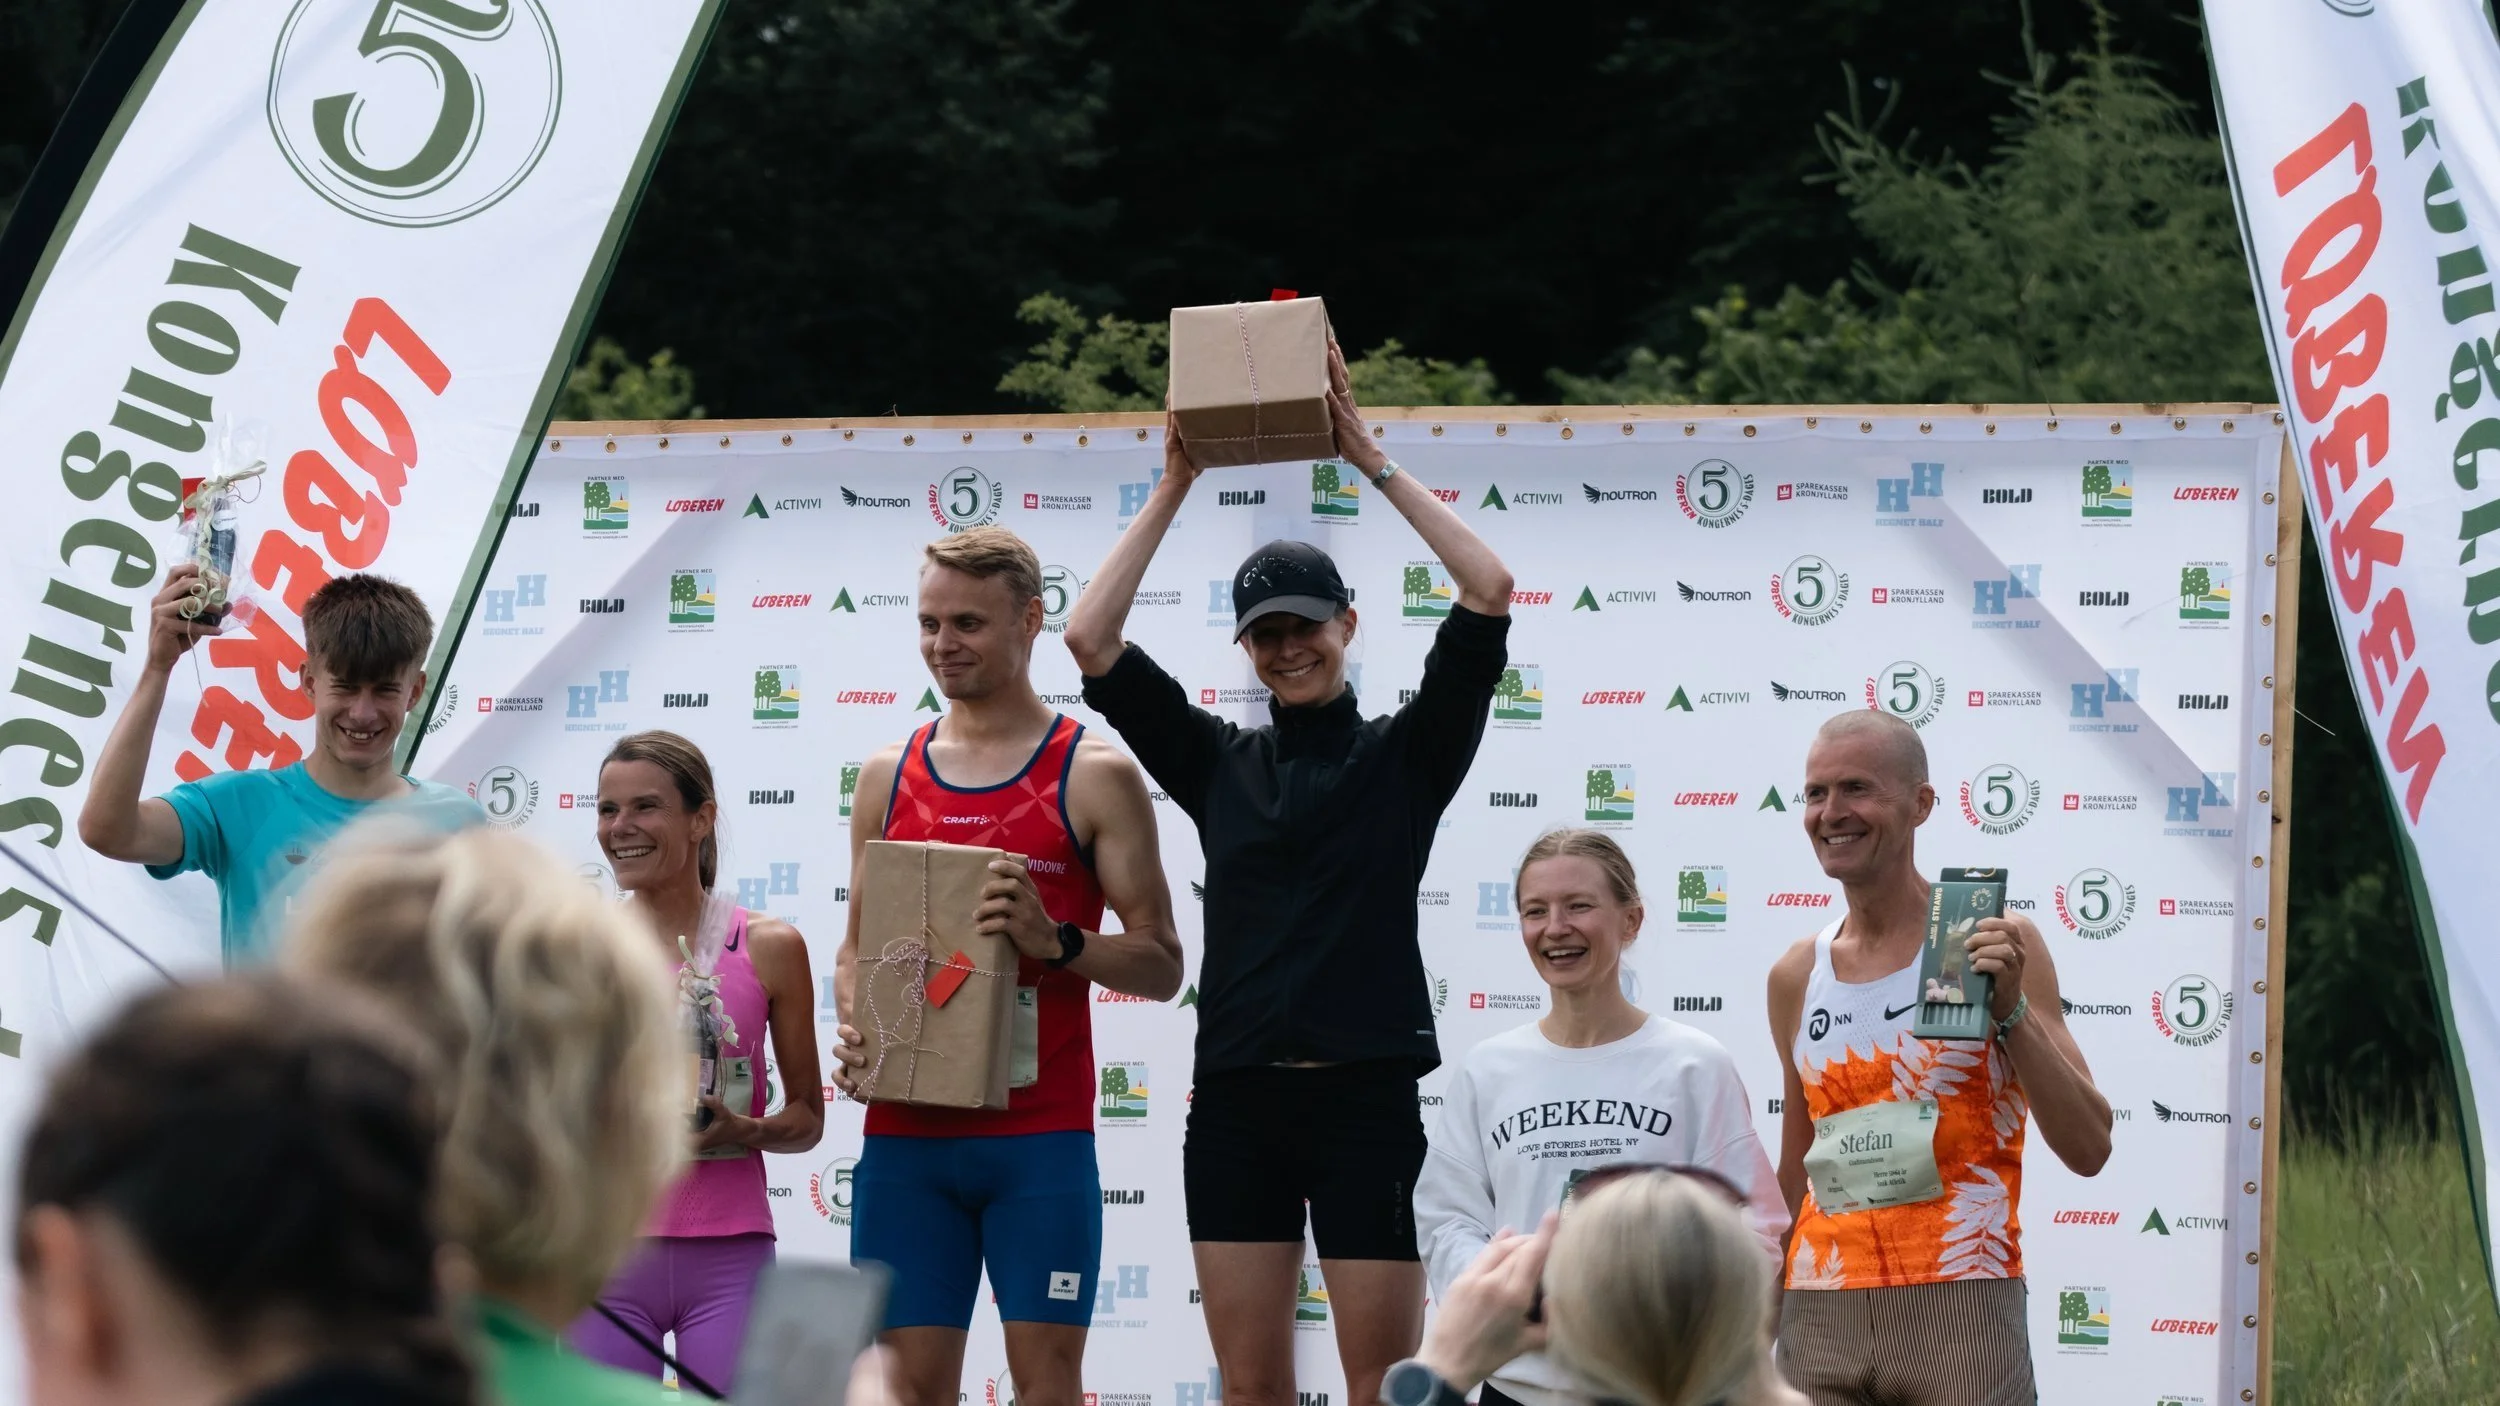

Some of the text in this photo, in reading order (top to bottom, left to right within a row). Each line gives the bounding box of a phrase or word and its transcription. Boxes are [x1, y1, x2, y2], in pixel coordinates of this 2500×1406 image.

[312, 0, 513, 198] 5
[950, 473, 980, 517] 5
[1698, 465, 1730, 512] 5
[1796, 483, 1847, 493] SPAREKASSEN
[2174, 487, 2239, 500] LØBEREN
[1219, 490, 1265, 505] BOLD
[1513, 493, 1562, 504] ACTIVIVI
[1796, 491, 1848, 500] KRONJYLLAND
[1983, 489, 2032, 503] BOLD
[666, 499, 725, 512] LØBEREN
[775, 498, 821, 510] ACTIVIVI
[1042, 502, 1091, 510] KRONJYLLAND
[1793, 562, 1824, 609] 5
[1607, 591, 1655, 602] ACTIVIVI
[1892, 589, 1944, 597] SPAREKASSEN
[2080, 592, 2129, 606] BOLD
[580, 599, 624, 613] BOLD
[752, 594, 811, 608] LØBEREN
[862, 595, 908, 606] ACTIVIVI
[1220, 688, 1271, 697] SPAREKASSEN
[1888, 667, 1917, 707] 5
[496, 698, 543, 706] SPAREKASSEN
[664, 694, 708, 707] BOLD
[837, 691, 896, 704] LØBEREN
[1582, 691, 1645, 704] LØBEREN
[1700, 692, 1749, 704] ACTIVIVI
[1988, 692, 2041, 700] SPAREKASSEN
[2179, 695, 2228, 709] BOLD
[488, 772, 515, 815] 5
[749, 790, 794, 804] BOLD
[1490, 792, 1537, 807] BOLD
[1674, 793, 1738, 806] LØBEREN
[1983, 771, 2013, 818] 5
[2084, 795, 2137, 804] SPAREKASSEN
[943, 816, 980, 824] CRAFT
[1767, 894, 1831, 907] LØBEREN
[1931, 887, 1944, 921] STRAWS
[2078, 875, 2110, 922] 5
[2180, 901, 2233, 909] SPAREKASSEN
[2180, 907, 2234, 916] KRONJYLLAND
[1489, 994, 1540, 1003] SPAREKASSEN
[1674, 997, 1722, 1011] BOLD
[2175, 981, 2206, 1029] 5
[1834, 1012, 1852, 1026] NN
[1490, 1099, 1672, 1151] WEEKEND
[1517, 1138, 1639, 1155] LOVE STORIES HOTEL NY
[1839, 1130, 1894, 1155] Stefan
[1541, 1150, 1568, 1159] HOURS
[1570, 1148, 1622, 1158] ROOMSERVICE
[2054, 1211, 2119, 1225] LØBEREN
[2176, 1216, 2229, 1232] ACTIVIVI
[2151, 1319, 2218, 1335] LØBEREN
